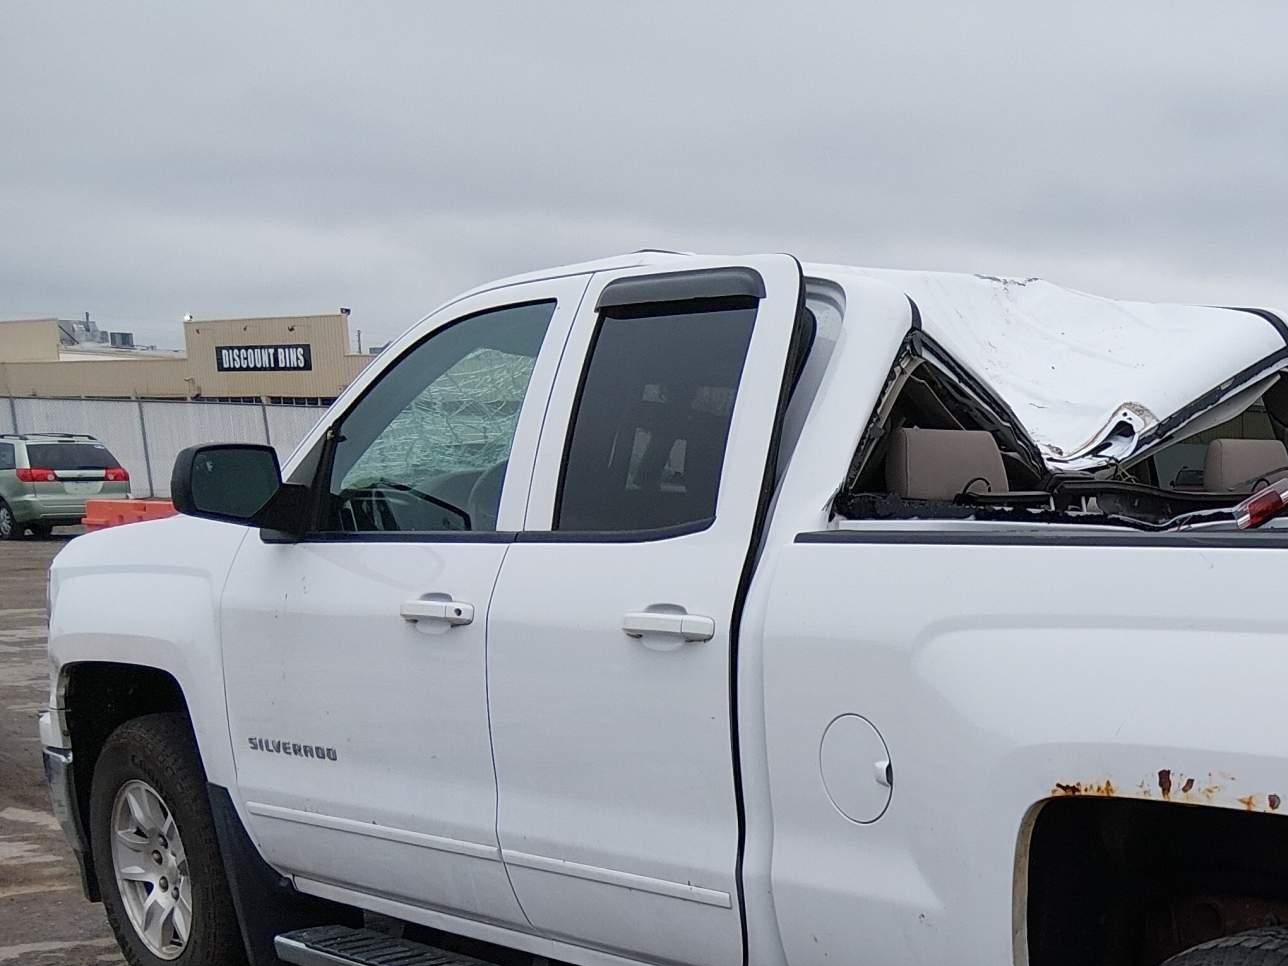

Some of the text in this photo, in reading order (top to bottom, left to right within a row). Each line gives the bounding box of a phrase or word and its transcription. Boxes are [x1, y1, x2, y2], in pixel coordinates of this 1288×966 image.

[221, 347, 305, 368] DISCOUNT BINS
[248, 737, 338, 761] SILVERADO
